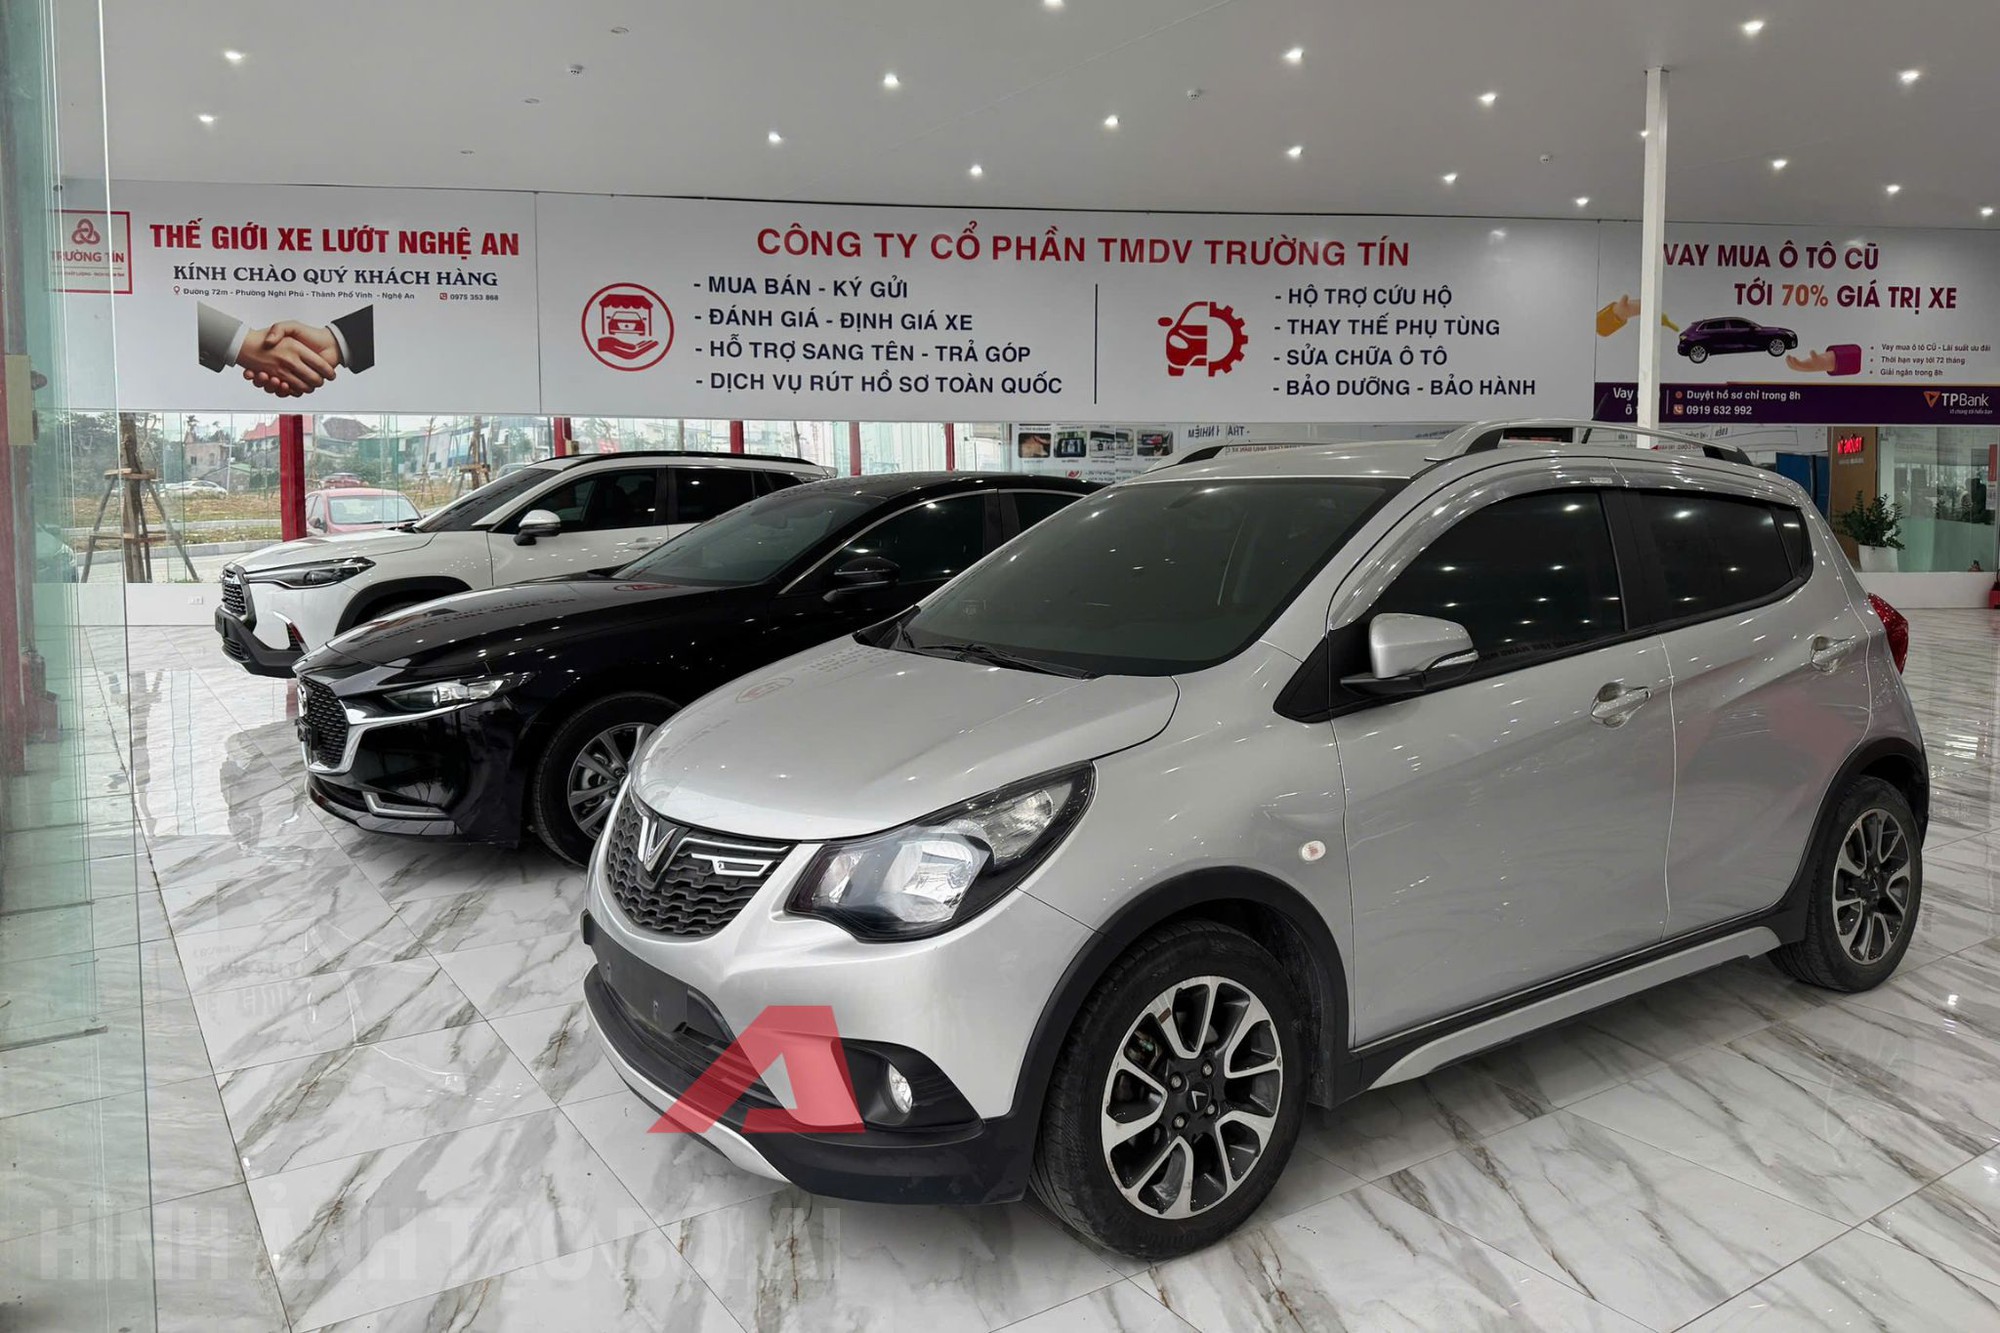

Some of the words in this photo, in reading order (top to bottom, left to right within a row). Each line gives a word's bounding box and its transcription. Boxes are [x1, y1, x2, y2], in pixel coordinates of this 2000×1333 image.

[150, 218, 202, 248] THẾ
[212, 222, 267, 250] GIỚI
[278, 228, 312, 251] XE
[323, 225, 389, 252] LƯỚT
[399, 227, 471, 260] NGHỆ
[481, 233, 518, 255] AN
[758, 223, 860, 257] CÔNG
[874, 233, 917, 258] TY
[931, 221, 980, 260] CỔ
[993, 226, 1084, 261] PHẦN
[1098, 238, 1192, 263] TMDV
[1204, 234, 1344, 265] TRƯỜNG
[1358, 236, 1408, 266] TÍN
[1664, 244, 1709, 266] VAY
[1718, 245, 1770, 267] MUA
[1779, 240, 1798, 268] Ô
[1806, 241, 1836, 269] TÔ
[1845, 243, 1878, 270] CŨ
[174, 263, 226, 280] KÍNH
[234, 264, 296, 282] CHÀO
[304, 266, 348, 284] QUÝ
[355, 267, 429, 284] KHÁCH
[437, 268, 497, 286] HÀNG
[709, 276, 756, 293] MUA
[765, 274, 810, 295] BÁN
[834, 276, 862, 296] KÝ
[870, 275, 907, 298] GỬI
[1289, 288, 1318, 307] HỘ
[1324, 287, 1367, 308] TRỢ
[1374, 285, 1415, 304] CỨU
[1424, 285, 1451, 308] HỘ
[1734, 277, 1772, 305] TỚI
[1782, 284, 1828, 306] 70%
[1837, 280, 1880, 307] GIÁ
[1888, 287, 1920, 314] TRỊ
[1929, 287, 1956, 308] XE
[709, 309, 772, 326] ĐÁNH
[781, 307, 818, 328] GIÁ
[840, 313, 892, 332] ĐỊNH
[901, 310, 937, 330] GIÁ
[946, 315, 972, 330] XE
[1287, 319, 1340, 334] THAY
[1348, 313, 1389, 334] THẾ
[1396, 320, 1437, 338] PHỤ
[1444, 316, 1499, 335] TÙNG
[711, 334, 742, 357] HỖ
[749, 341, 795, 362] TRỢ
[803, 343, 863, 360] SANG
[871, 341, 913, 361] TÊN
[935, 340, 978, 361] TRẢ
[986, 342, 1030, 362] GÓP
[1287, 343, 1328, 365] SỬA
[1336, 346, 1392, 365] CHỮA
[1400, 346, 1413, 365] Ô
[1420, 346, 1447, 365] TÔ
[711, 373, 763, 392] DỊCH
[773, 374, 801, 394] VỤ
[811, 371, 853, 391] RÚT
[862, 370, 892, 392] HỒ
[900, 375, 929, 392] SƠ
[935, 373, 993, 393] TOÀN
[1002, 371, 1061, 394] QUỐC
[1287, 374, 1329, 395] BẢO
[1337, 376, 1409, 395] DƯỠNG
[1431, 374, 1473, 395] BẢO
[1480, 376, 1535, 395] HÀNH
[1613, 387, 1634, 401] Vay
[1789, 391, 1800, 400] 8h
[1942, 393, 1989, 406] TPBank
[1626, 404, 1632, 414] ô
[1687, 406, 1710, 414] 0919
[1714, 406, 1731, 414] 632
[1734, 406, 1752, 414] 992
